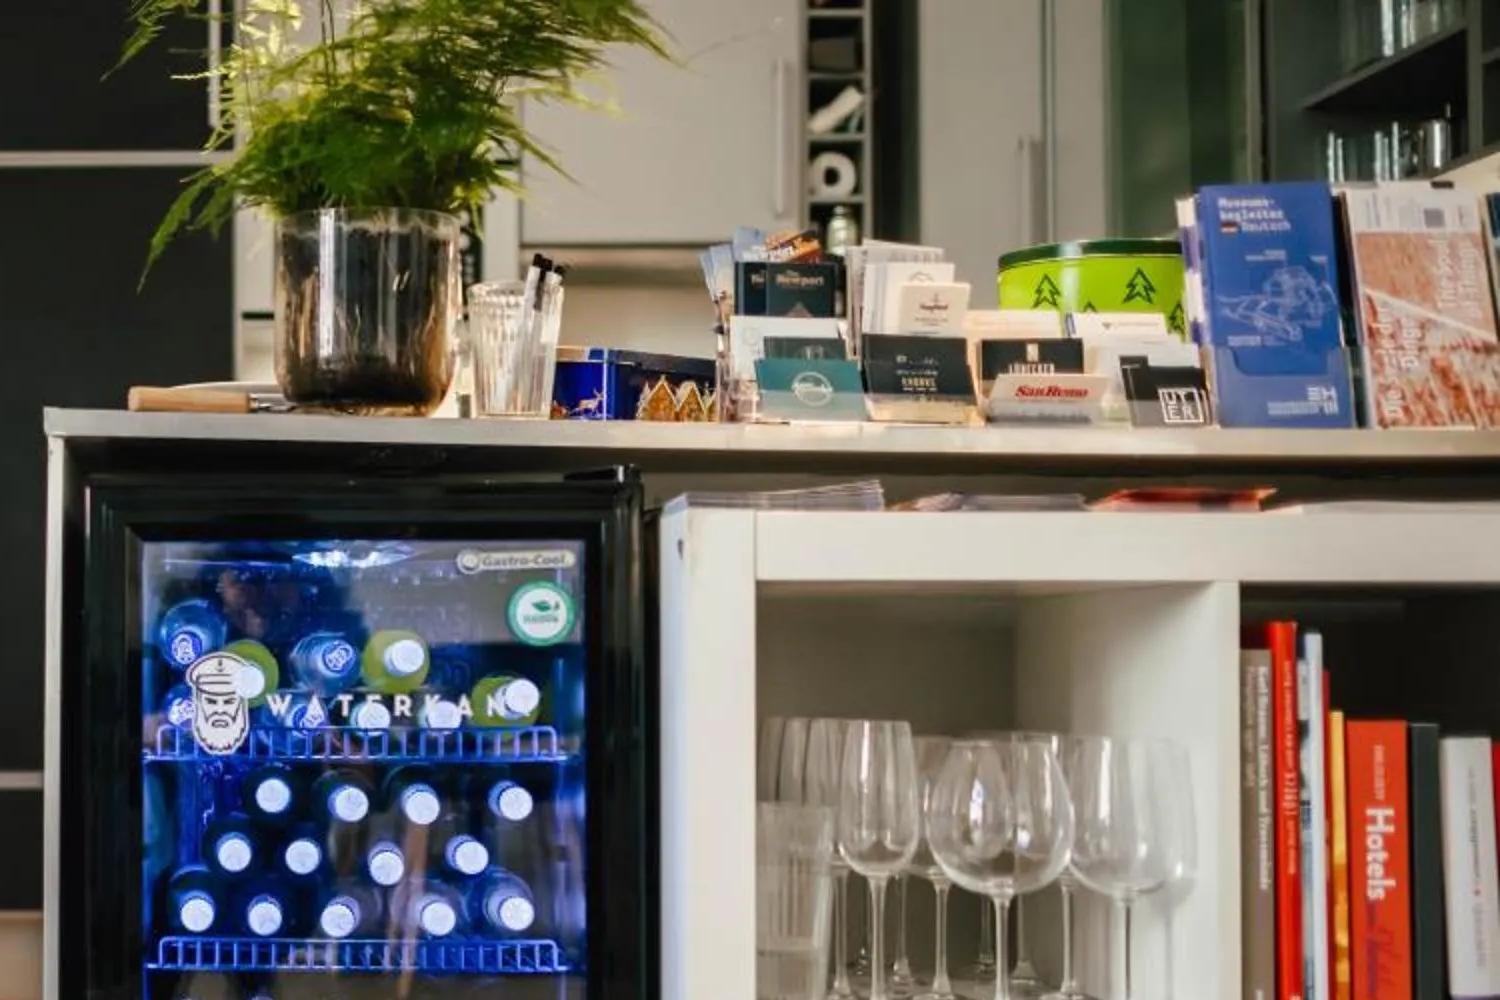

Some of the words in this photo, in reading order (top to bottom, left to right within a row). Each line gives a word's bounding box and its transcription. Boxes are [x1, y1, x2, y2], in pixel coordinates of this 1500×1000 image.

[1219, 209, 1284, 221] begleiter
[1241, 221, 1292, 232] Deutsch
[482, 553, 566, 566] Gastro-Cool
[266, 694, 532, 717] WATERKAN
[1365, 806, 1396, 901] Hotels
